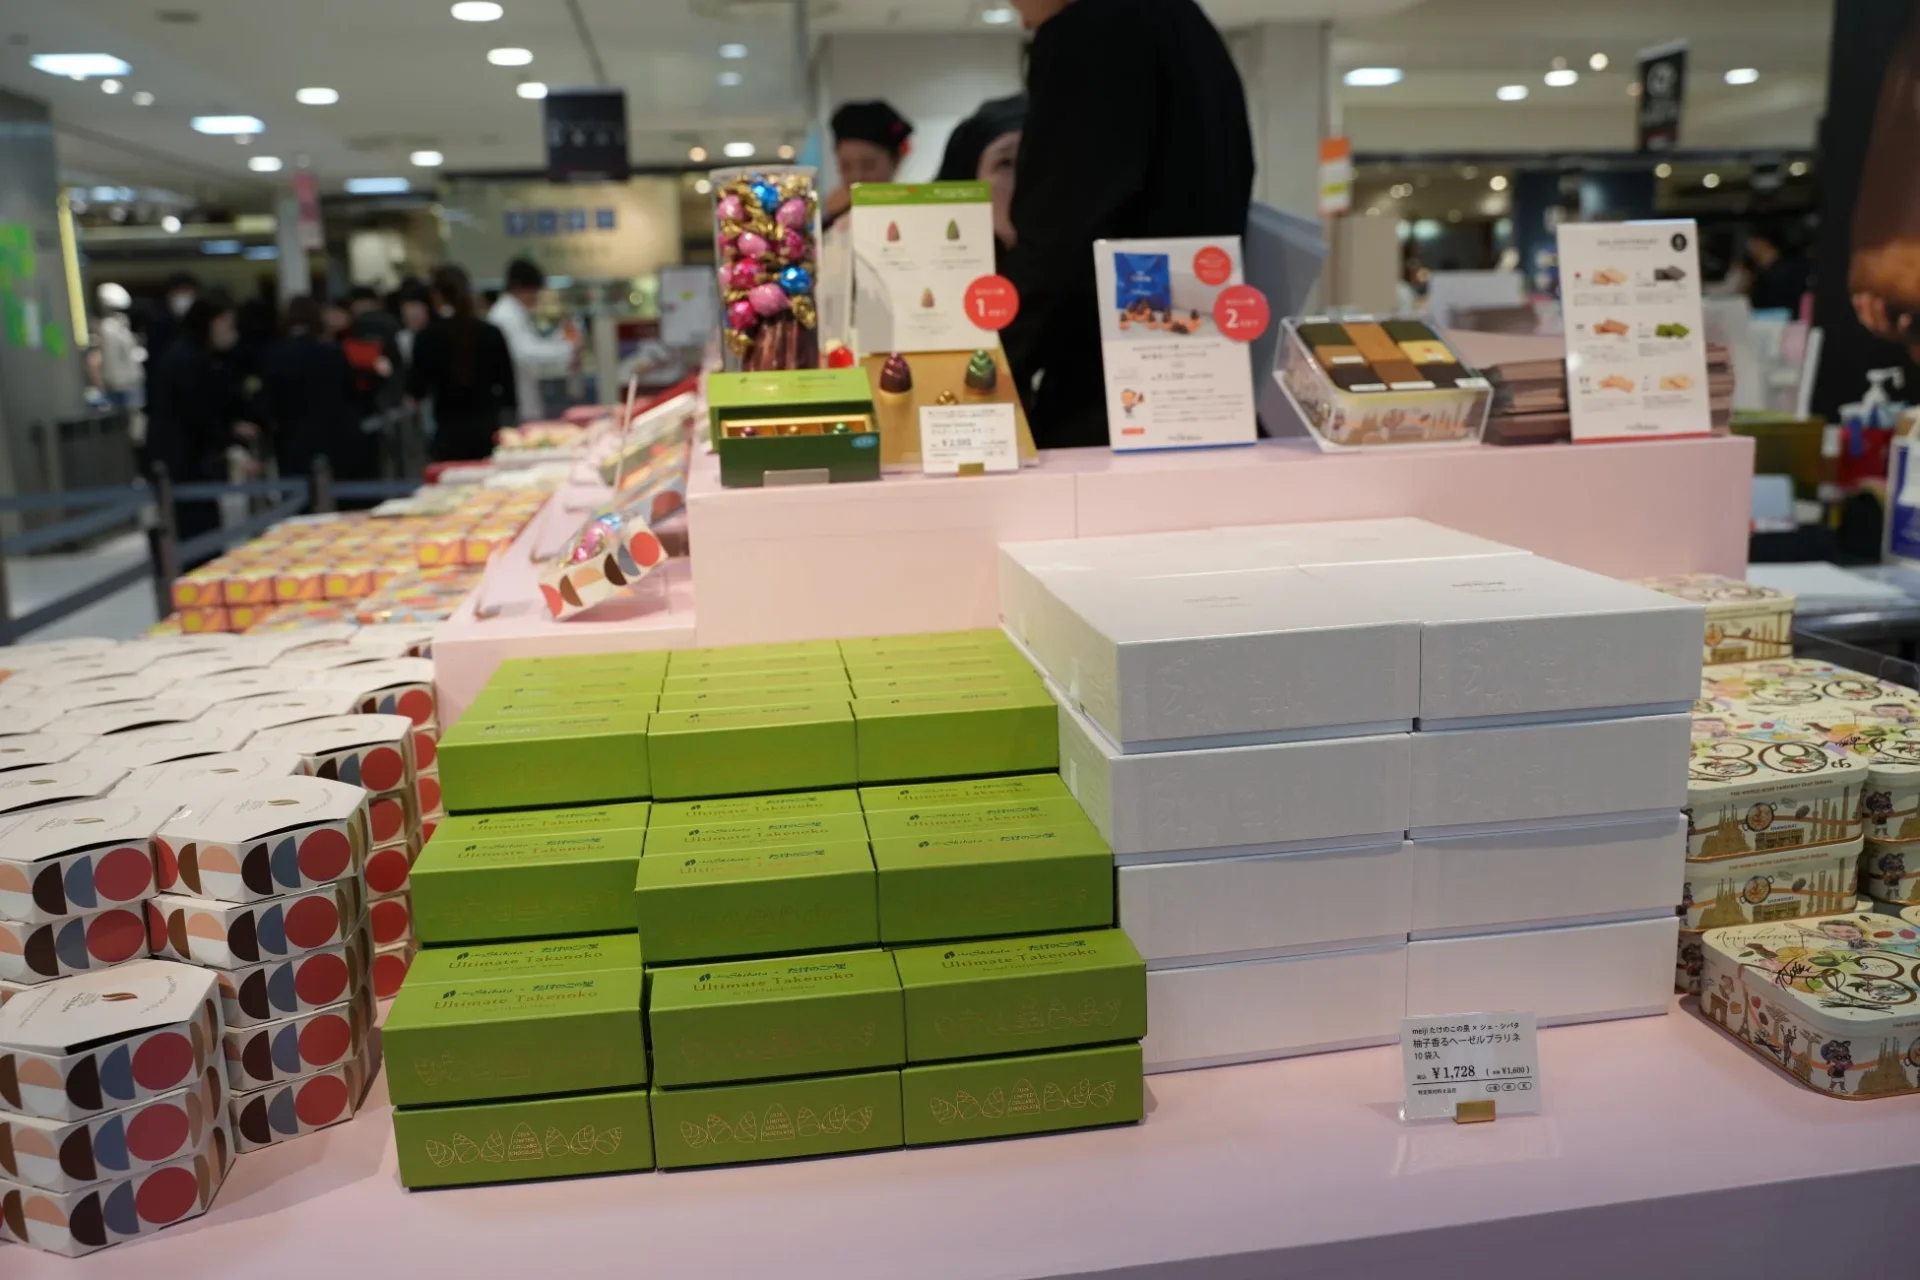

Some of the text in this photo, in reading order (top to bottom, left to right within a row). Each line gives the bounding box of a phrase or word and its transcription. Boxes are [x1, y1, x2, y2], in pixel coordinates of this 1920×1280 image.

[1225, 308, 1239, 329] 2
[448, 957, 518, 969] Ultimate
[525, 951, 603, 963] Takenoko
[942, 956, 1013, 969] Ultimate
[1019, 948, 1097, 961] Takenoko
[693, 979, 767, 992] Ultimate
[773, 972, 854, 985] Takenoko
[433, 996, 507, 1009] Ultimate
[515, 990, 599, 1003] Takenoko
[1412, 1027, 1429, 1036] meiji
[1430, 1024, 1471, 1033] たけのこの里
[1480, 1022, 1520, 1031] シェ・シバタ
[1413, 1032, 1521, 1049] 柚子香るヘーゼルプラリネ
[1431, 1065, 1476, 1080] ¥1,728
